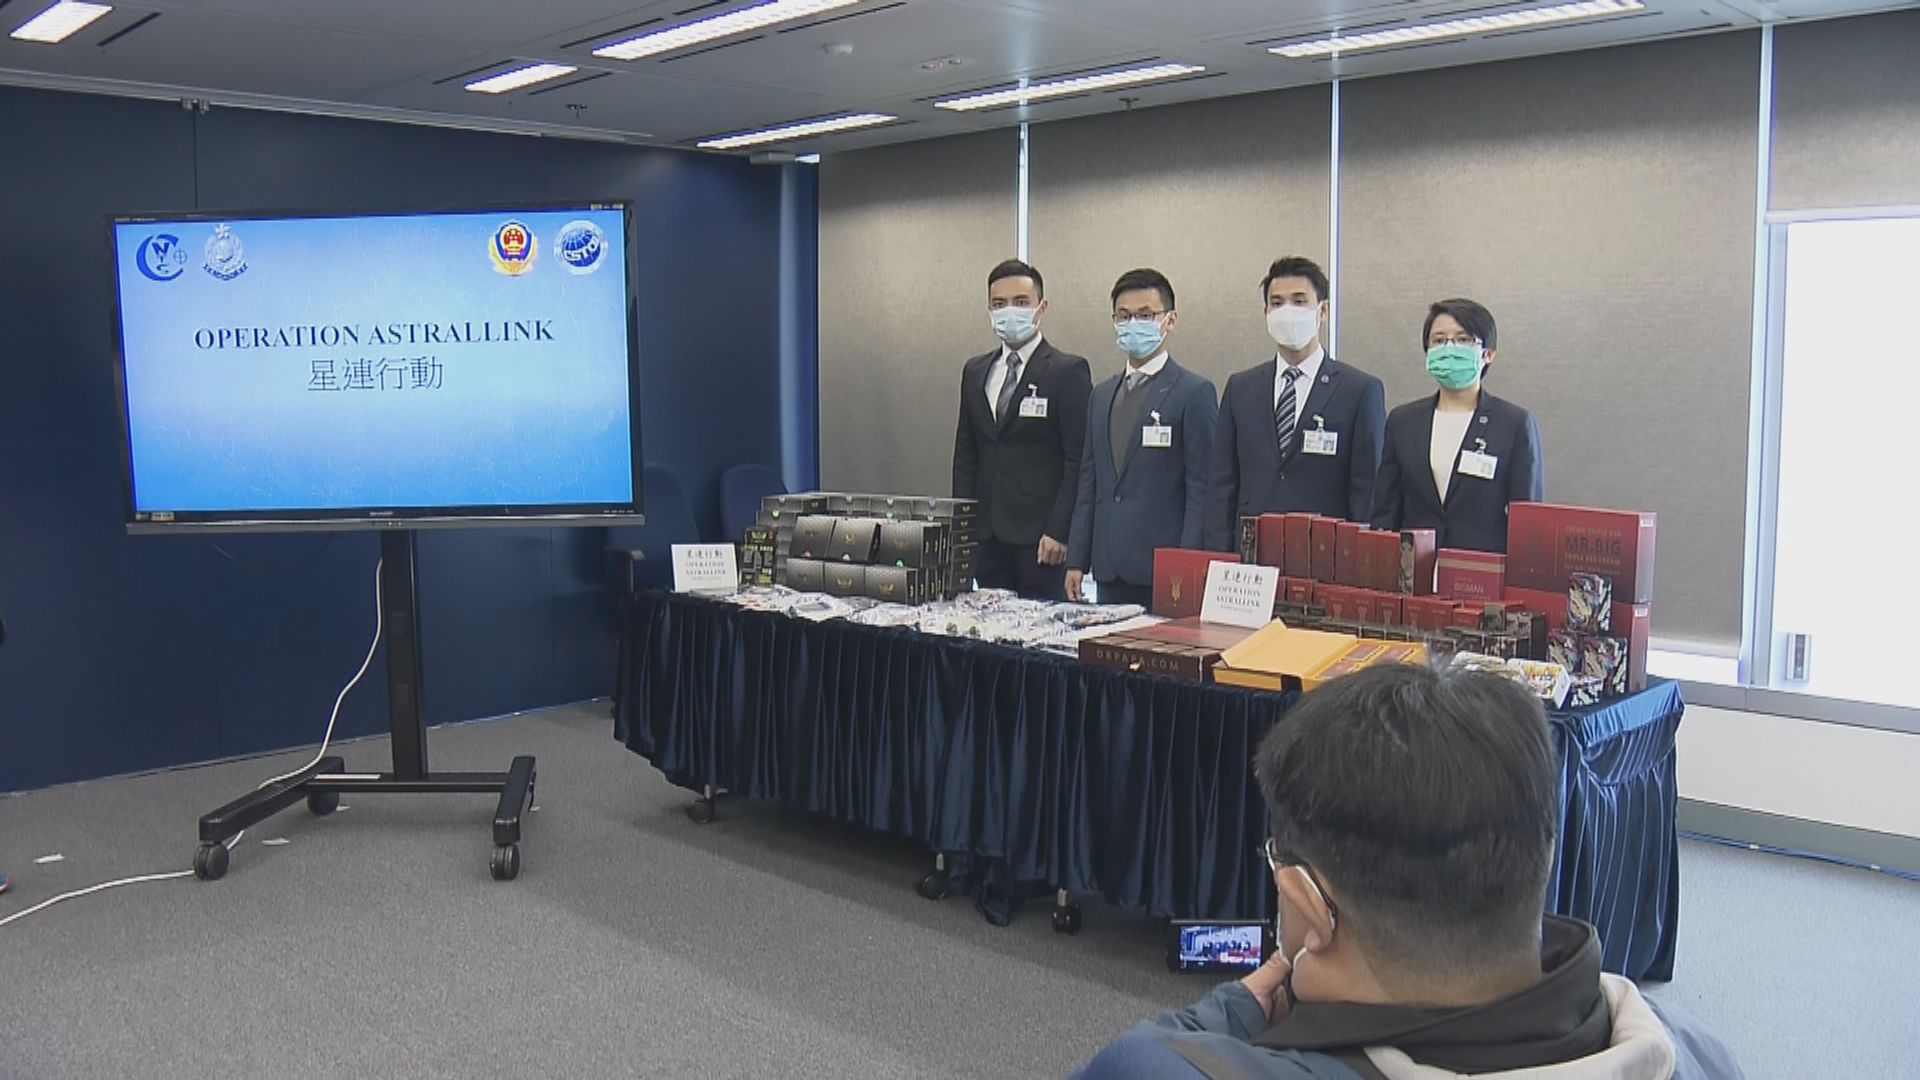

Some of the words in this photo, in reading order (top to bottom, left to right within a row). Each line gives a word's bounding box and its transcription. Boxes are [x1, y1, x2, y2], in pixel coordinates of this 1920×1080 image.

[194, 325, 359, 350] OPERATION
[367, 320, 555, 346] ASTRALLINK
[307, 356, 443, 392] 星連行動
